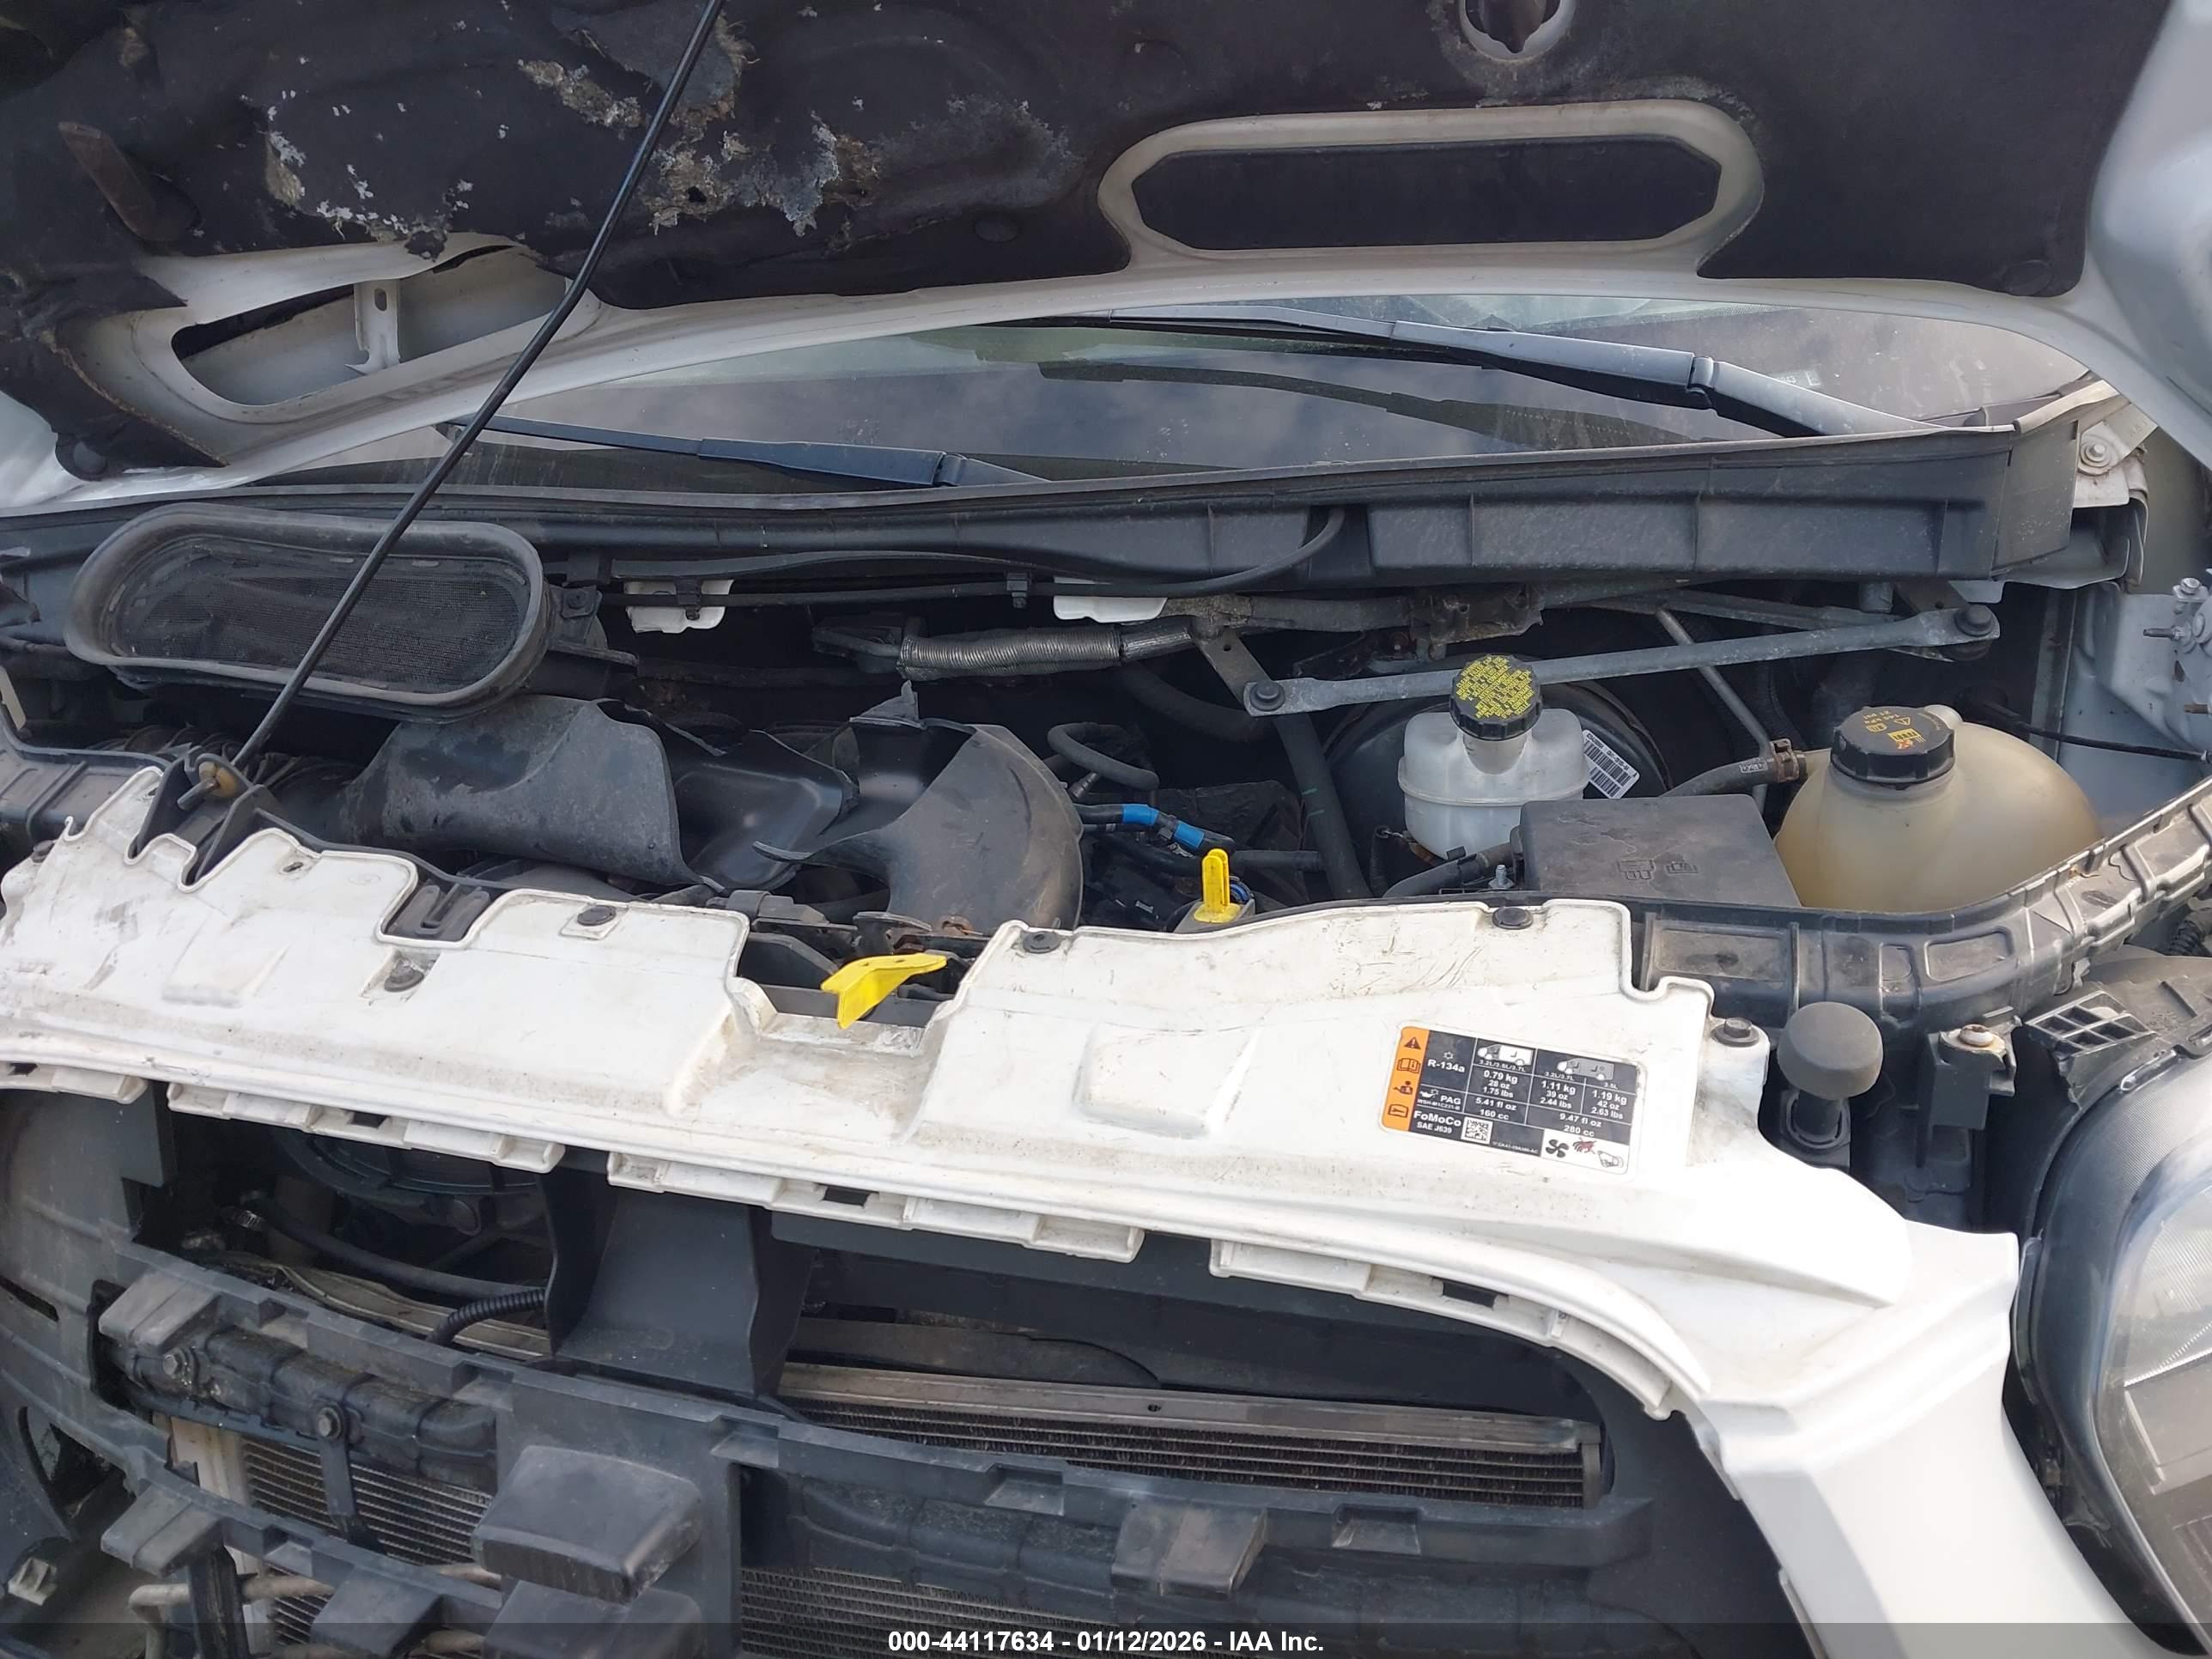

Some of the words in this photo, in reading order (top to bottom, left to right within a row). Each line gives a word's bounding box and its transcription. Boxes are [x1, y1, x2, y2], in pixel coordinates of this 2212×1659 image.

[1427, 1059, 1465, 1073] R-134a
[1484, 1070, 1504, 1080] 0.79
[1505, 1073, 1518, 1085] kg
[1483, 1086, 1499, 1095] 1.75
[1540, 1080, 1561, 1090] 1.11
[1564, 1084, 1577, 1096] kg
[1440, 1095, 1462, 1105] PAG
[1475, 1097, 1494, 1106] 5.41
[1540, 1097, 1558, 1106] 2.44
[1559, 1100, 1572, 1109] lbs
[1592, 1090, 1613, 1101] 1.19
[1614, 1094, 1628, 1106] kg
[1413, 1110, 1462, 1127] FoMoCo
[1480, 1109, 1496, 1117] 160
[1559, 1113, 1580, 1122] 9.47
[1590, 1107, 1609, 1116] 2.63
[1610, 1110, 1624, 1120] lbs
[1417, 1121, 1433, 1131] SAE
[1433, 1124, 1453, 1134] J639
[1564, 1125, 1581, 1134] 280
